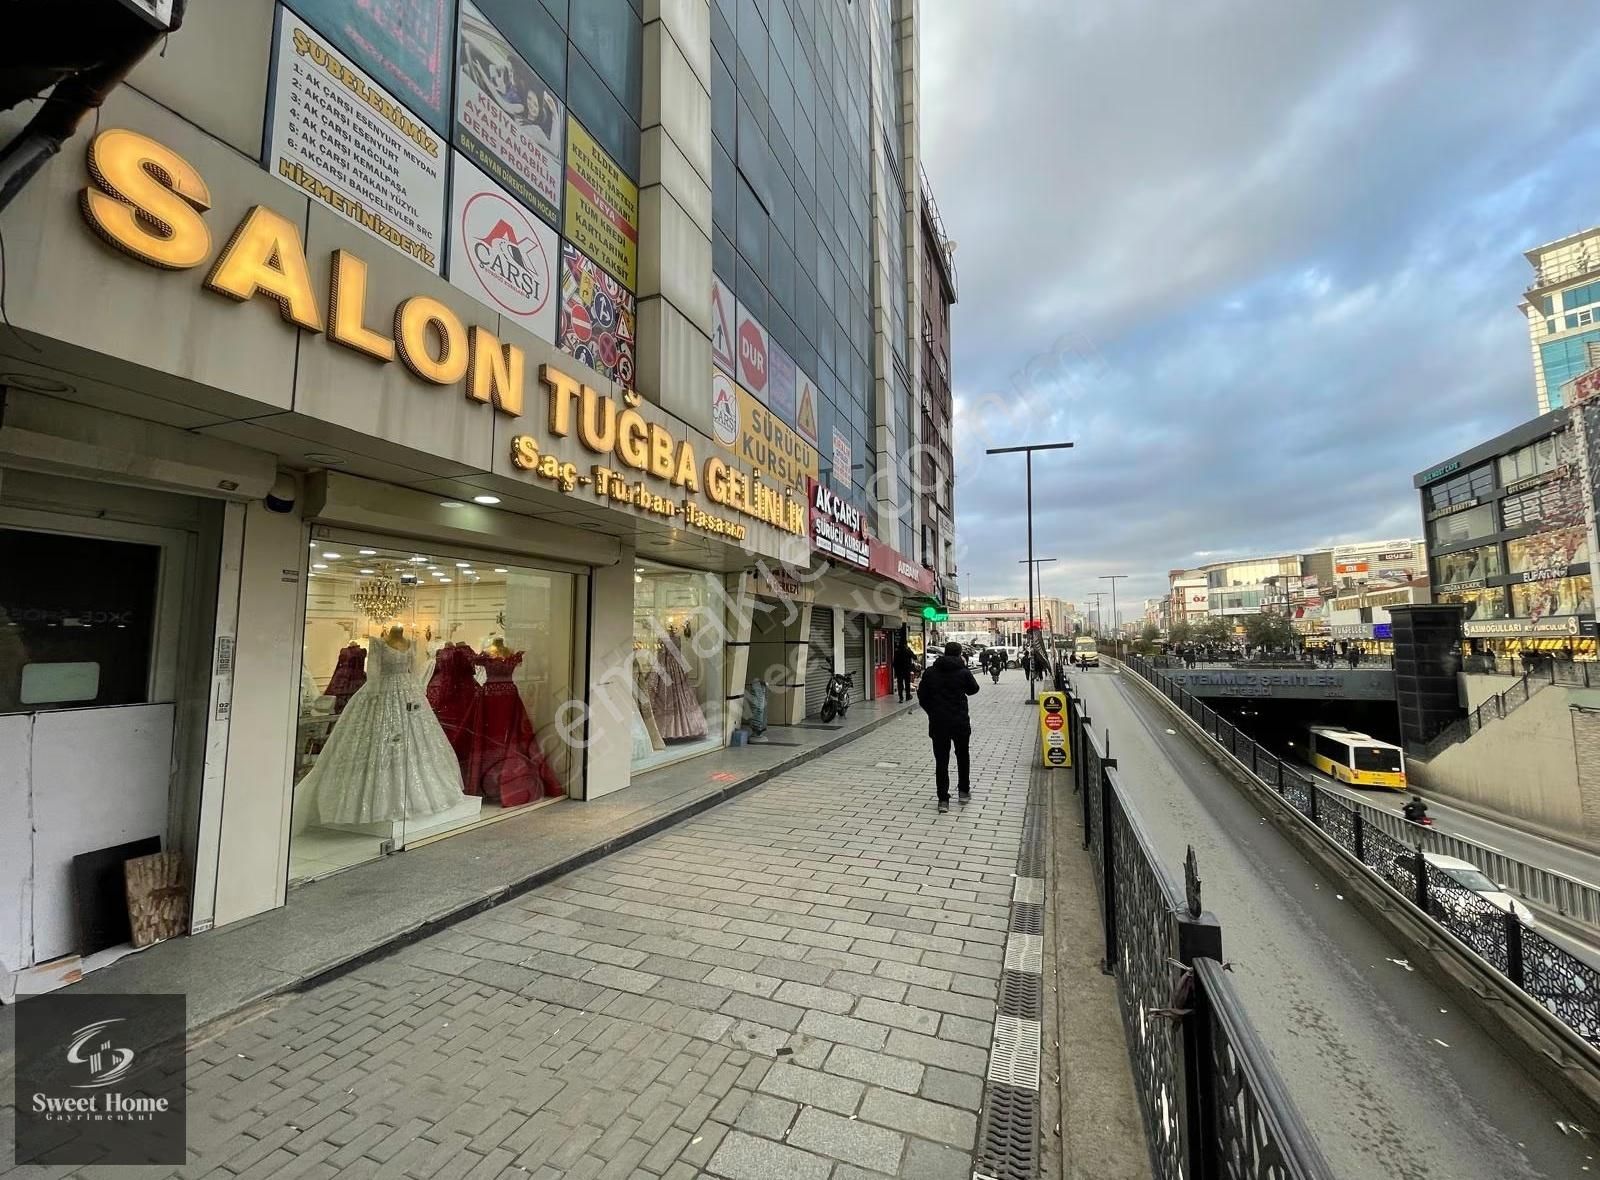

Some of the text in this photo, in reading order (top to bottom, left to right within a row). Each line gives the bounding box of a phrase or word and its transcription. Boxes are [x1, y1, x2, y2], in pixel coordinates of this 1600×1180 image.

[290, 92, 301, 105] 3:
[303, 102, 318, 118] AK
[321, 114, 352, 143] ÇARŞI
[291, 78, 302, 90] 2:
[353, 124, 399, 163] ESENYURT
[293, 28, 438, 158] ŞUBELERİMİZ
[293, 63, 437, 178] 1: AK ÇARŞI ESENYURT MEYDAN
[289, 108, 407, 196] 4: AK ÇARŞI KEMALPAŞA
[460, 134, 475, 154] BAY
[479, 150, 502, 176] BAYAN
[463, 111, 497, 149] DERS
[287, 138, 298, 150] 6:
[349, 178, 415, 228] BAHÇELİEVLER
[416, 223, 433, 240] SRC
[288, 122, 419, 218] 5: AK ÇARŞI ATAKAN YÜZYIL
[592, 145, 620, 182] ELDEN
[278, 157, 435, 268] HİZMETİNİZDEYİZ
[580, 198, 626, 248] TÜM KREDİ
[593, 193, 617, 222] VEYA
[575, 212, 629, 265] KARTLARINA
[575, 230, 629, 281] 12 AY TAKSİT
[475, 241, 541, 301] ÇARŞI
[79, 128, 526, 417] SALON
[538, 362, 700, 493] TUĞBA
[704, 456, 807, 537] GELİNLİK
[742, 338, 764, 373] DUR
[743, 432, 806, 494] KURSLA
[751, 409, 811, 469] SÜRÜCÜ
[815, 485, 860, 532] AK ÇARŞI
[815, 518, 843, 545] SÜRÜCÜ
